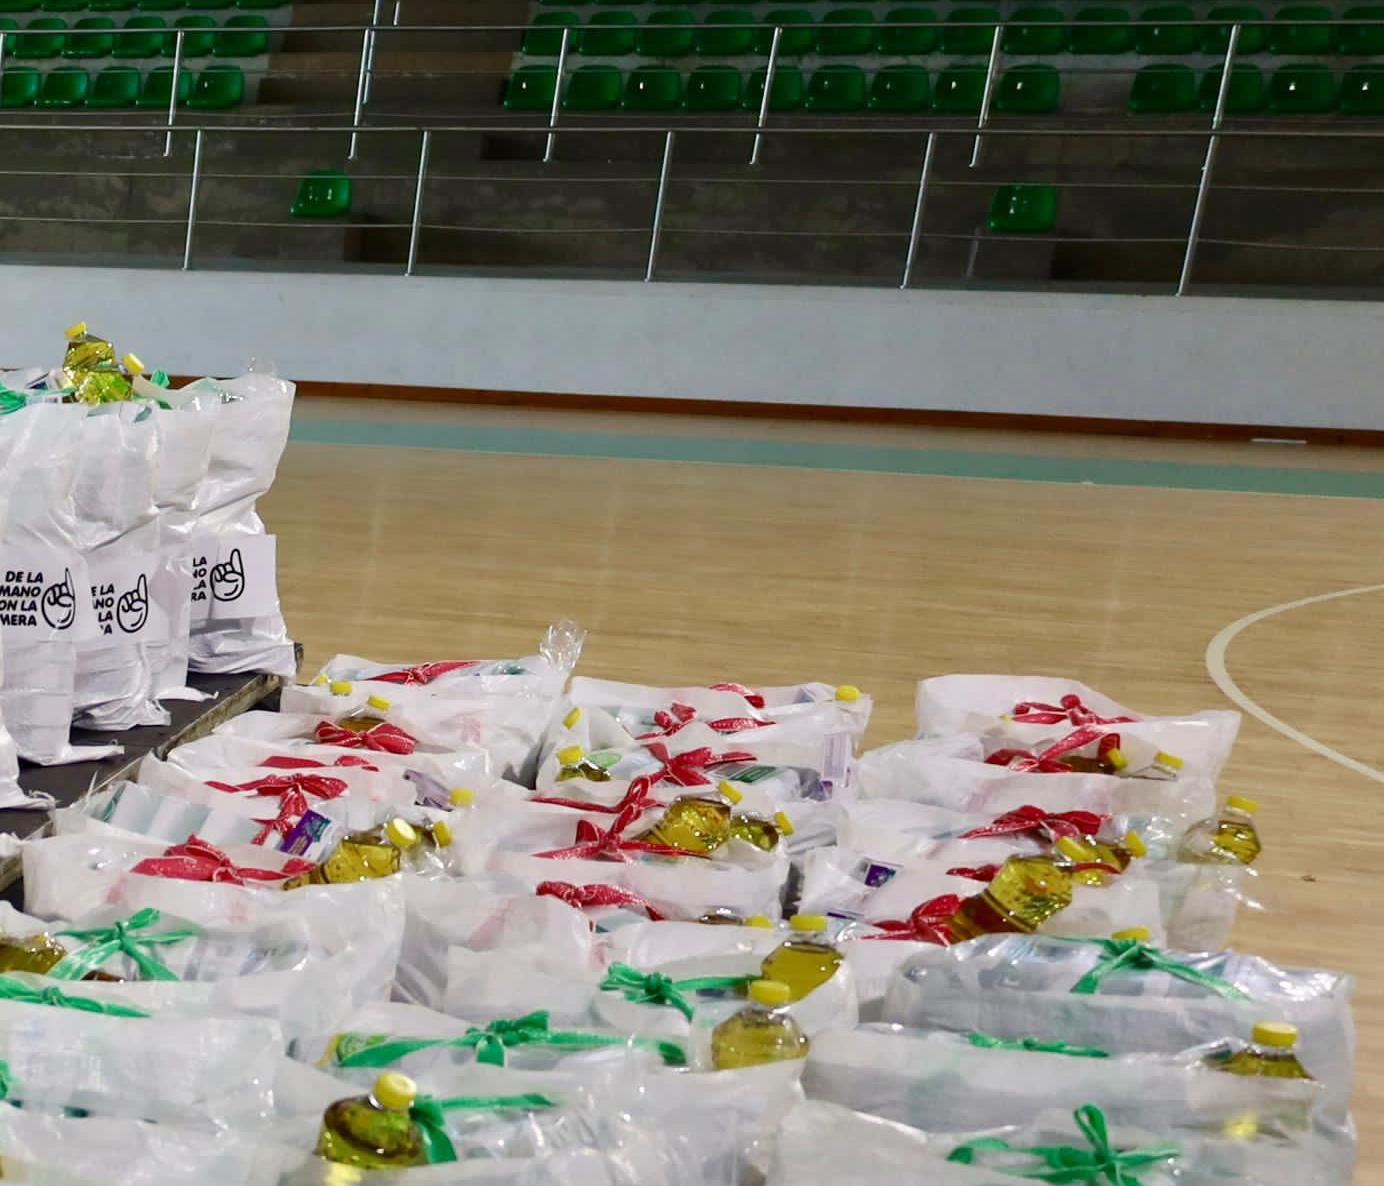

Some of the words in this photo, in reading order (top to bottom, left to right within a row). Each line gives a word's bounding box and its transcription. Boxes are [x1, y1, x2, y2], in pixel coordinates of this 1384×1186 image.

[193, 556, 207, 567] LA
[5, 571, 25, 584] DE
[27, 572, 43, 584] LA
[100, 583, 114, 596] LA
[21, 600, 38, 612] LA
[98, 611, 113, 622] LA
